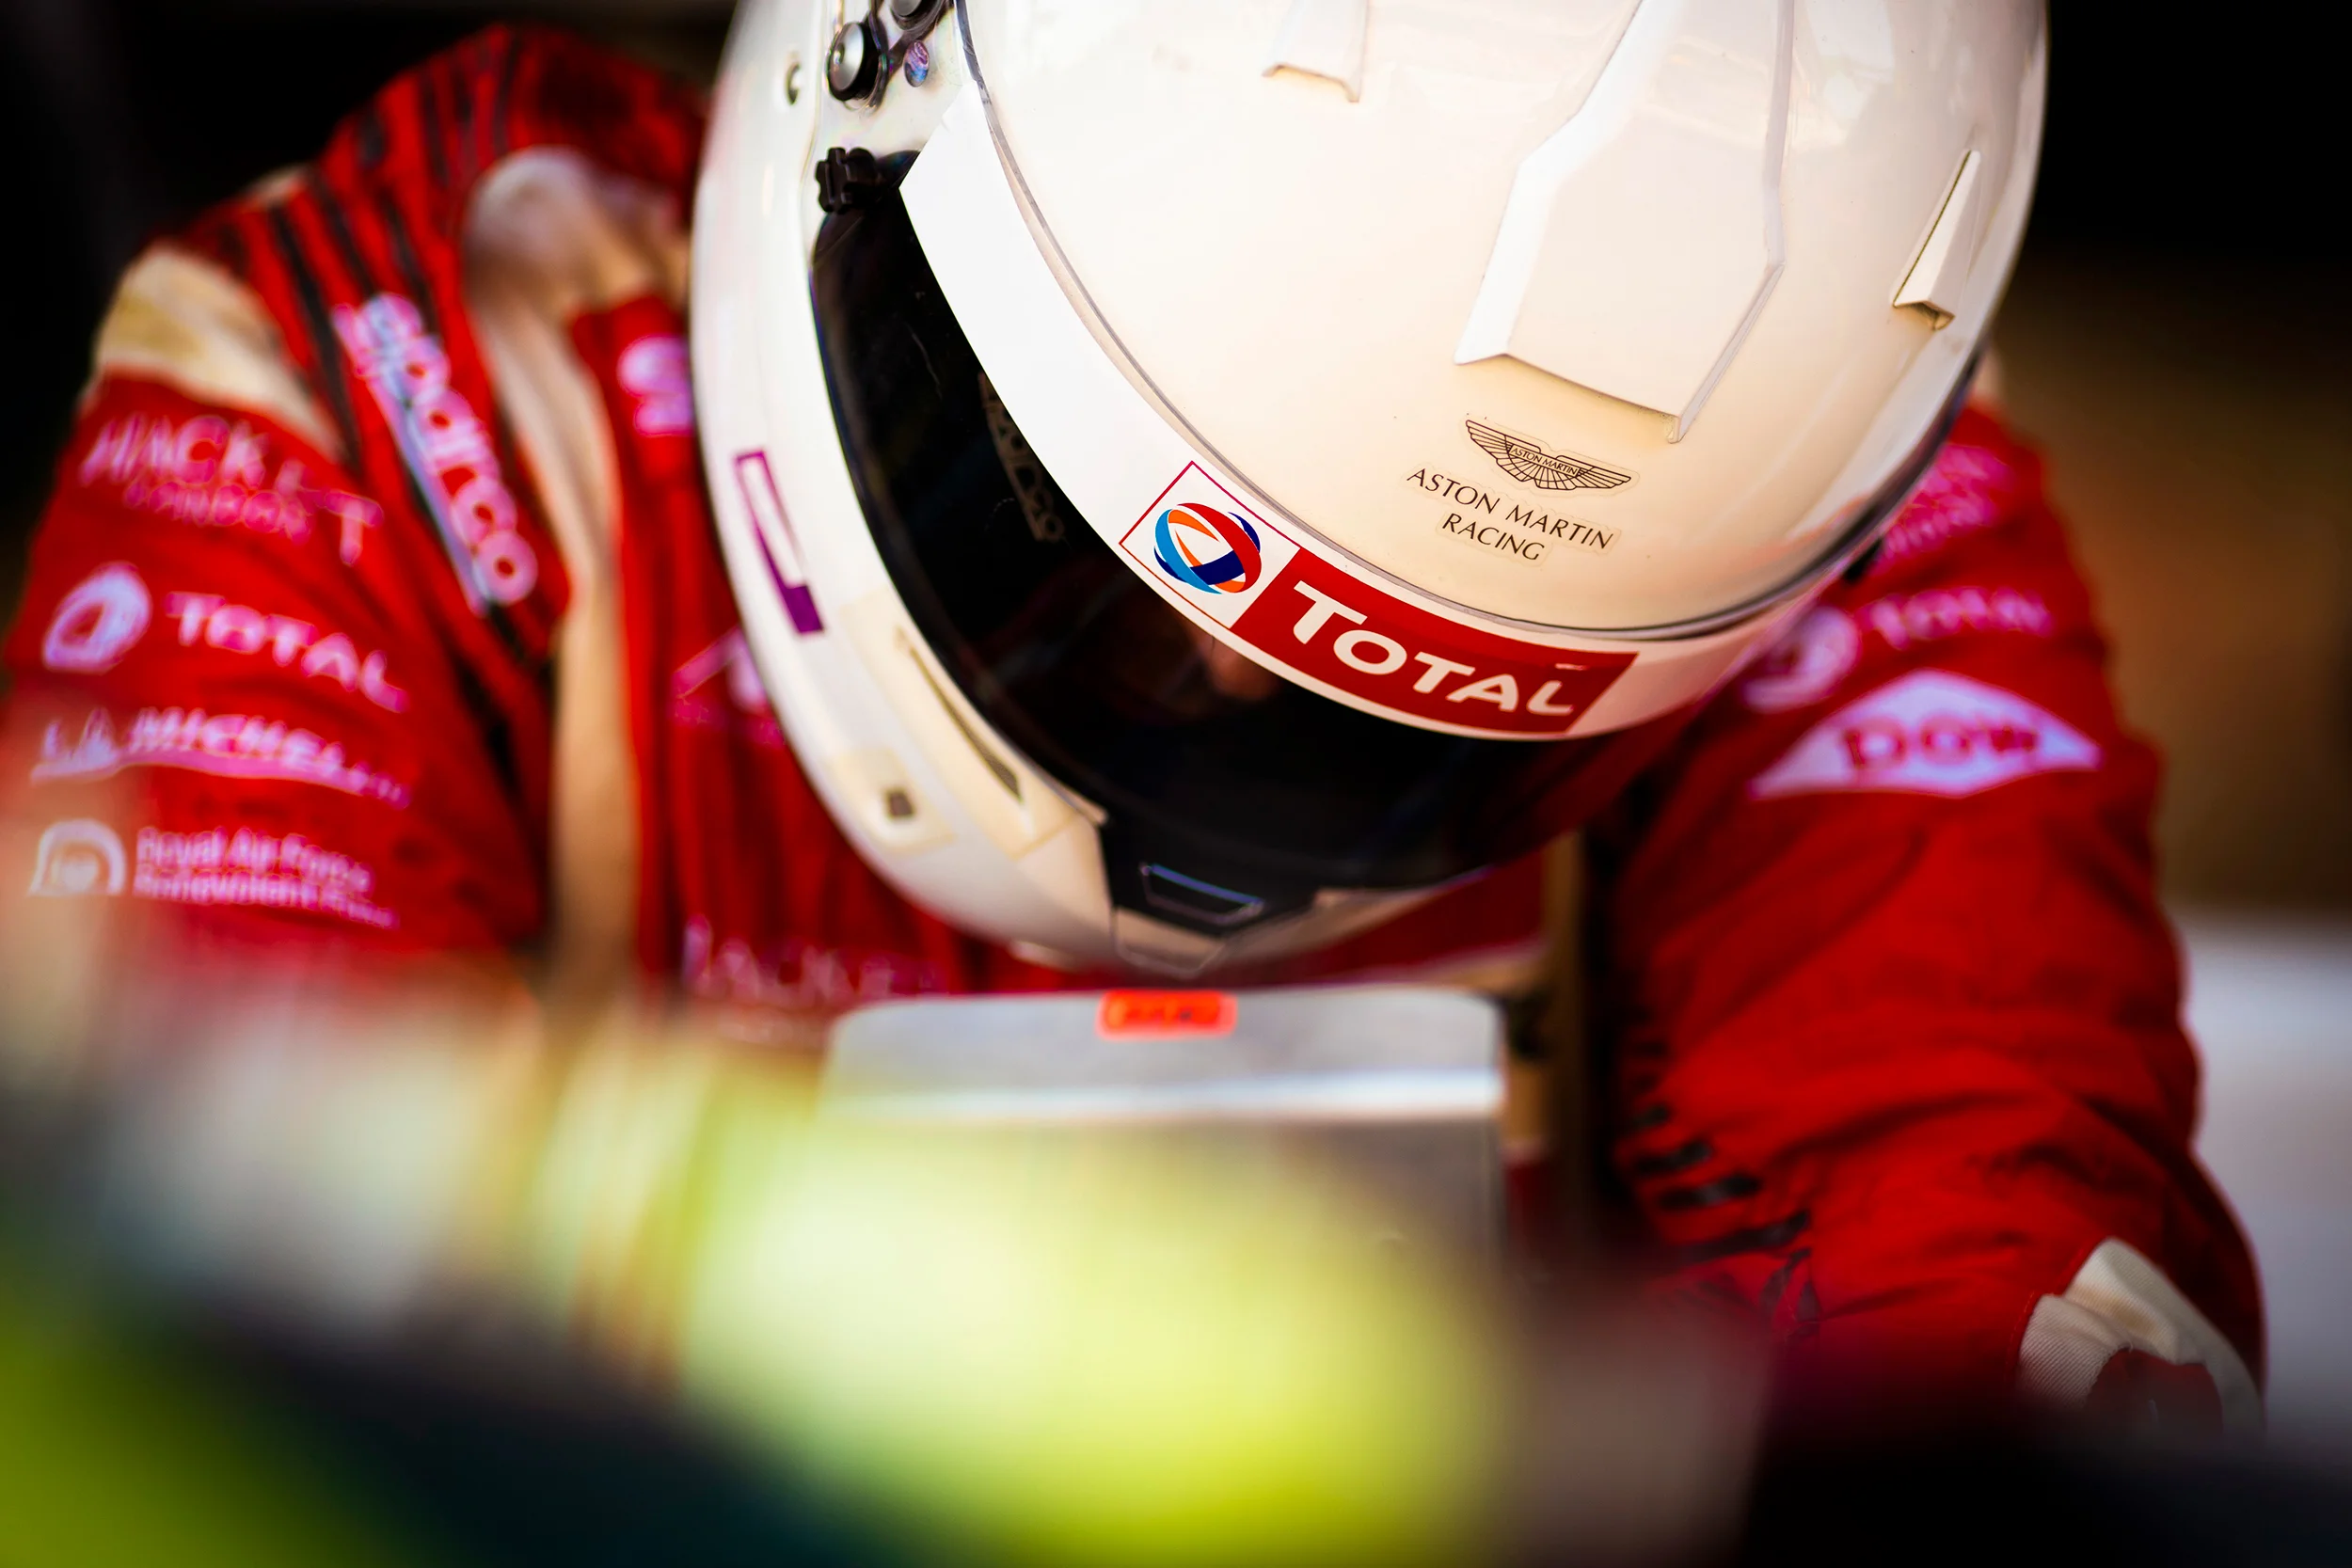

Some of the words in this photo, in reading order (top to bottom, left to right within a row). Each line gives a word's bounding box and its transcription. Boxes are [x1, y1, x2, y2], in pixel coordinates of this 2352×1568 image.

[1510, 446, 1542, 465] ASTON
[1542, 457, 1579, 477] MARTIN
[1406, 467, 1501, 515] ASTON
[1504, 504, 1614, 549] MARTIN
[1441, 513, 1546, 562] RACING
[165, 590, 410, 714] TOTAL
[1292, 579, 1575, 717] TOTAL
